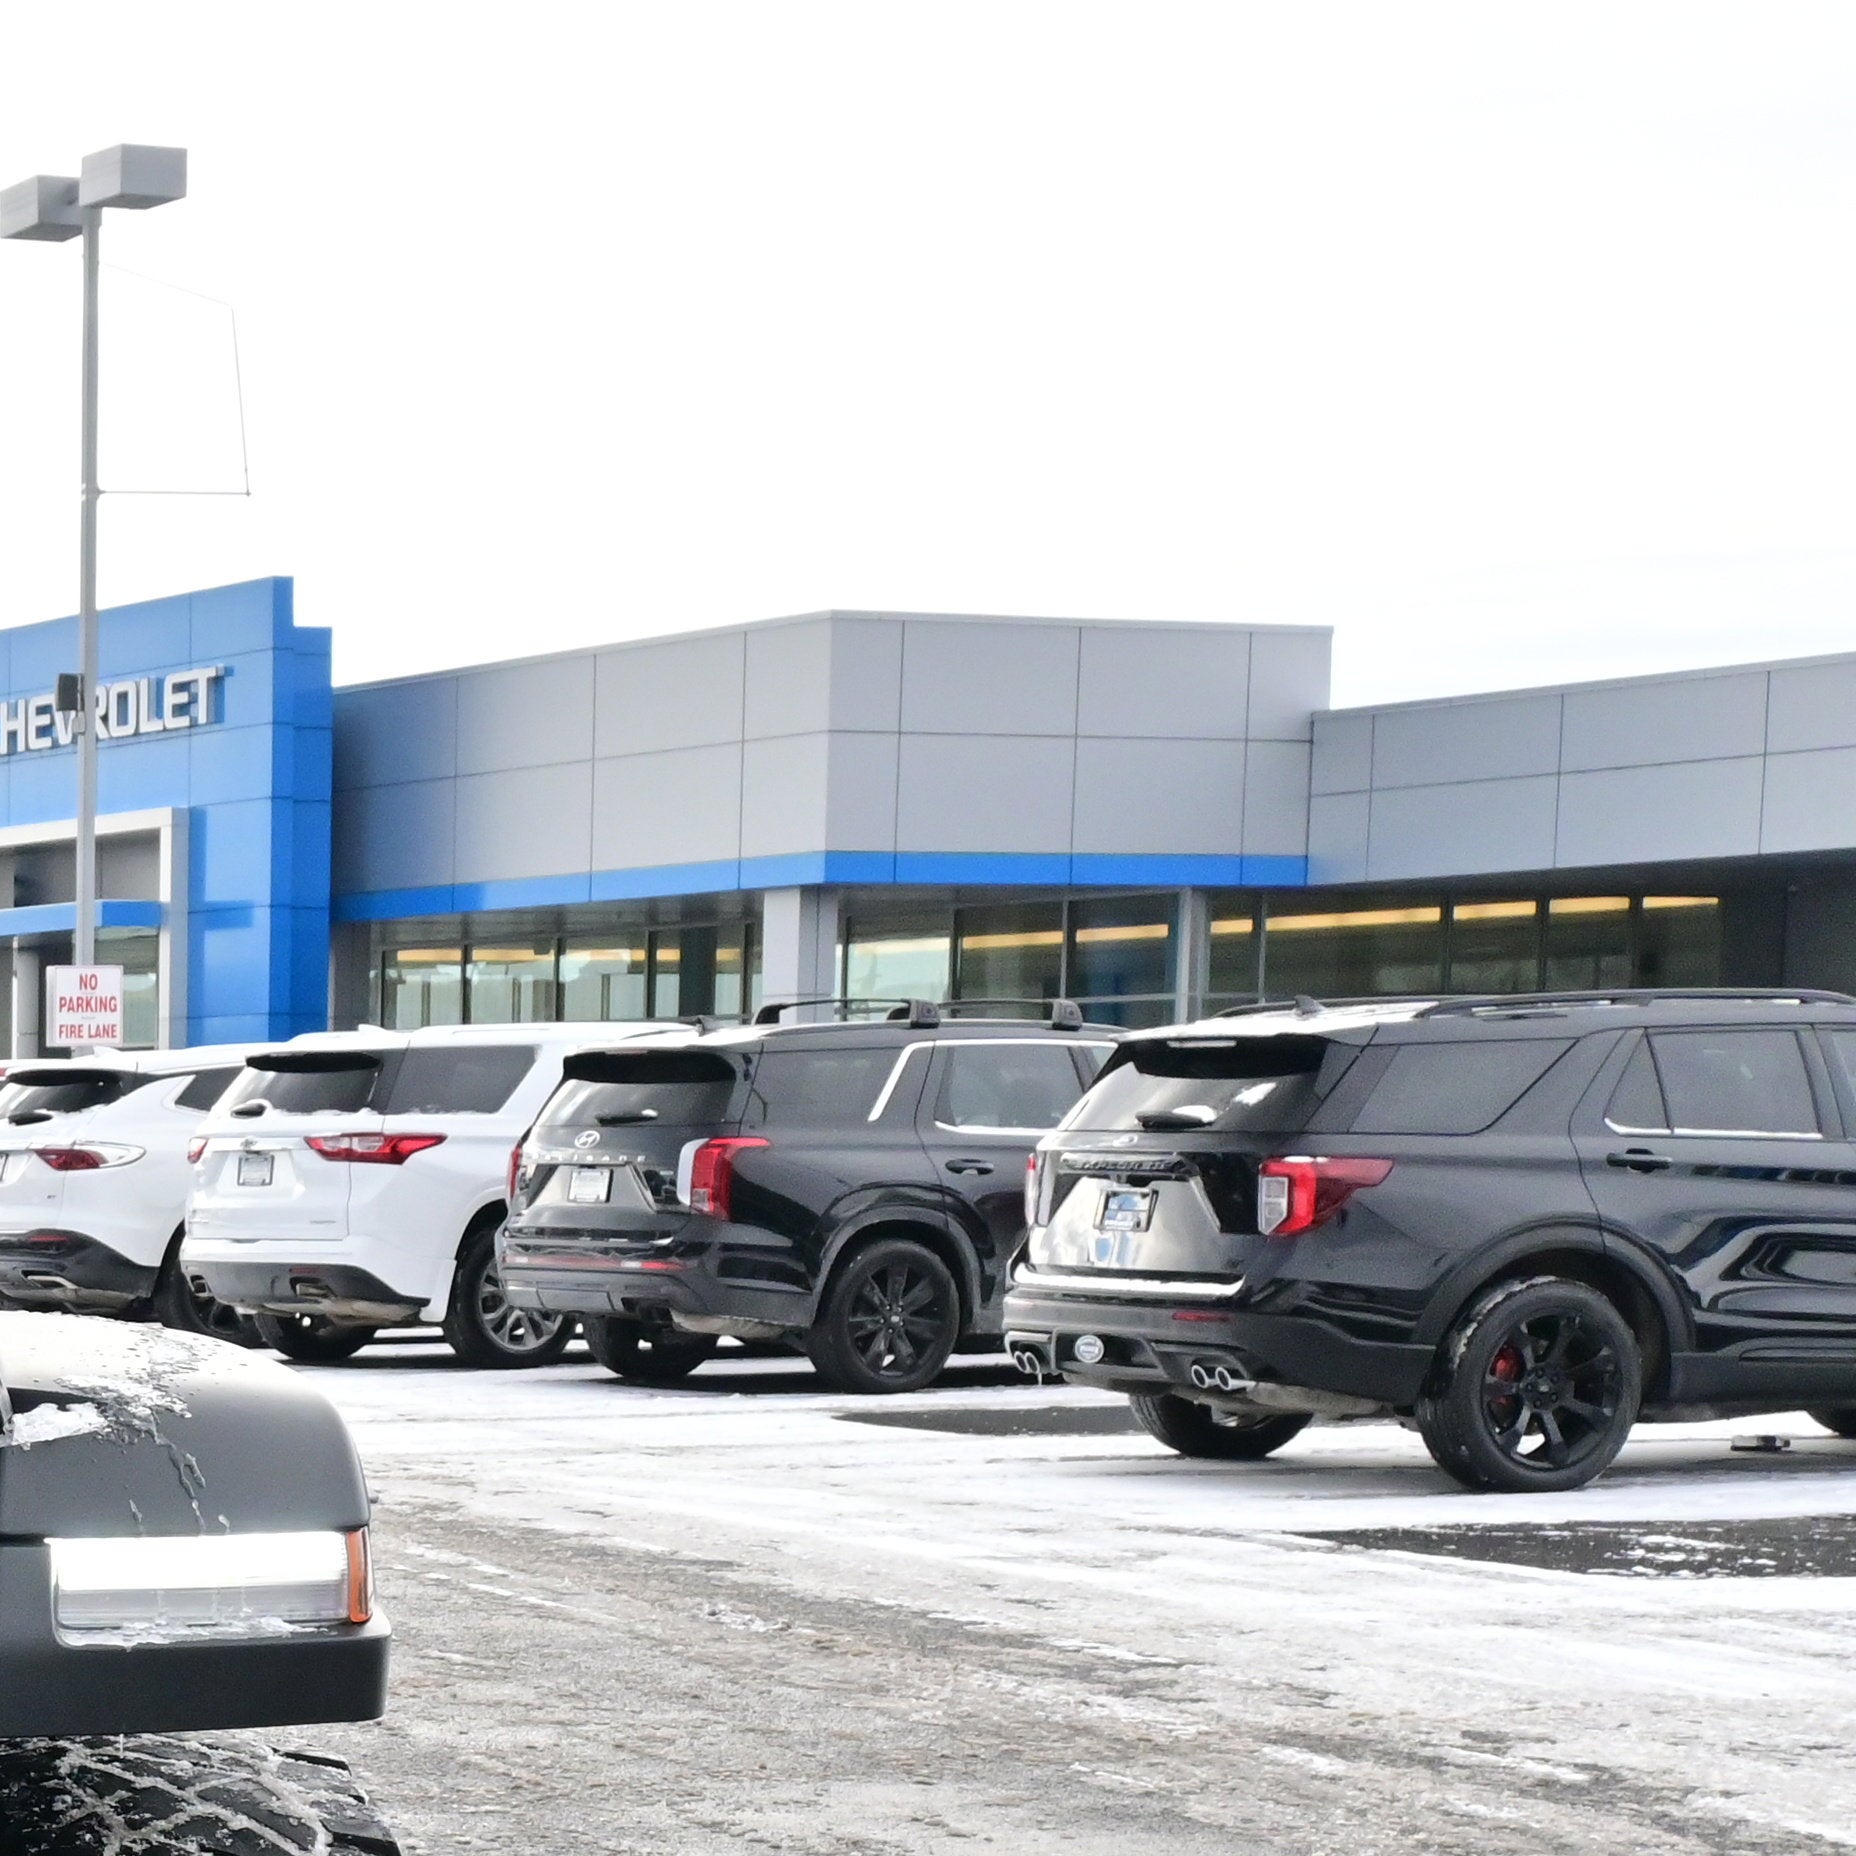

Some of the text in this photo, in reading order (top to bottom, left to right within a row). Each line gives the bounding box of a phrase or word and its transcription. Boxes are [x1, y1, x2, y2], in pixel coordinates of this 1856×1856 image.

[79, 973, 98, 990] NO
[59, 996, 117, 1013] PARKING
[59, 1024, 117, 1039] FIRE LANE
